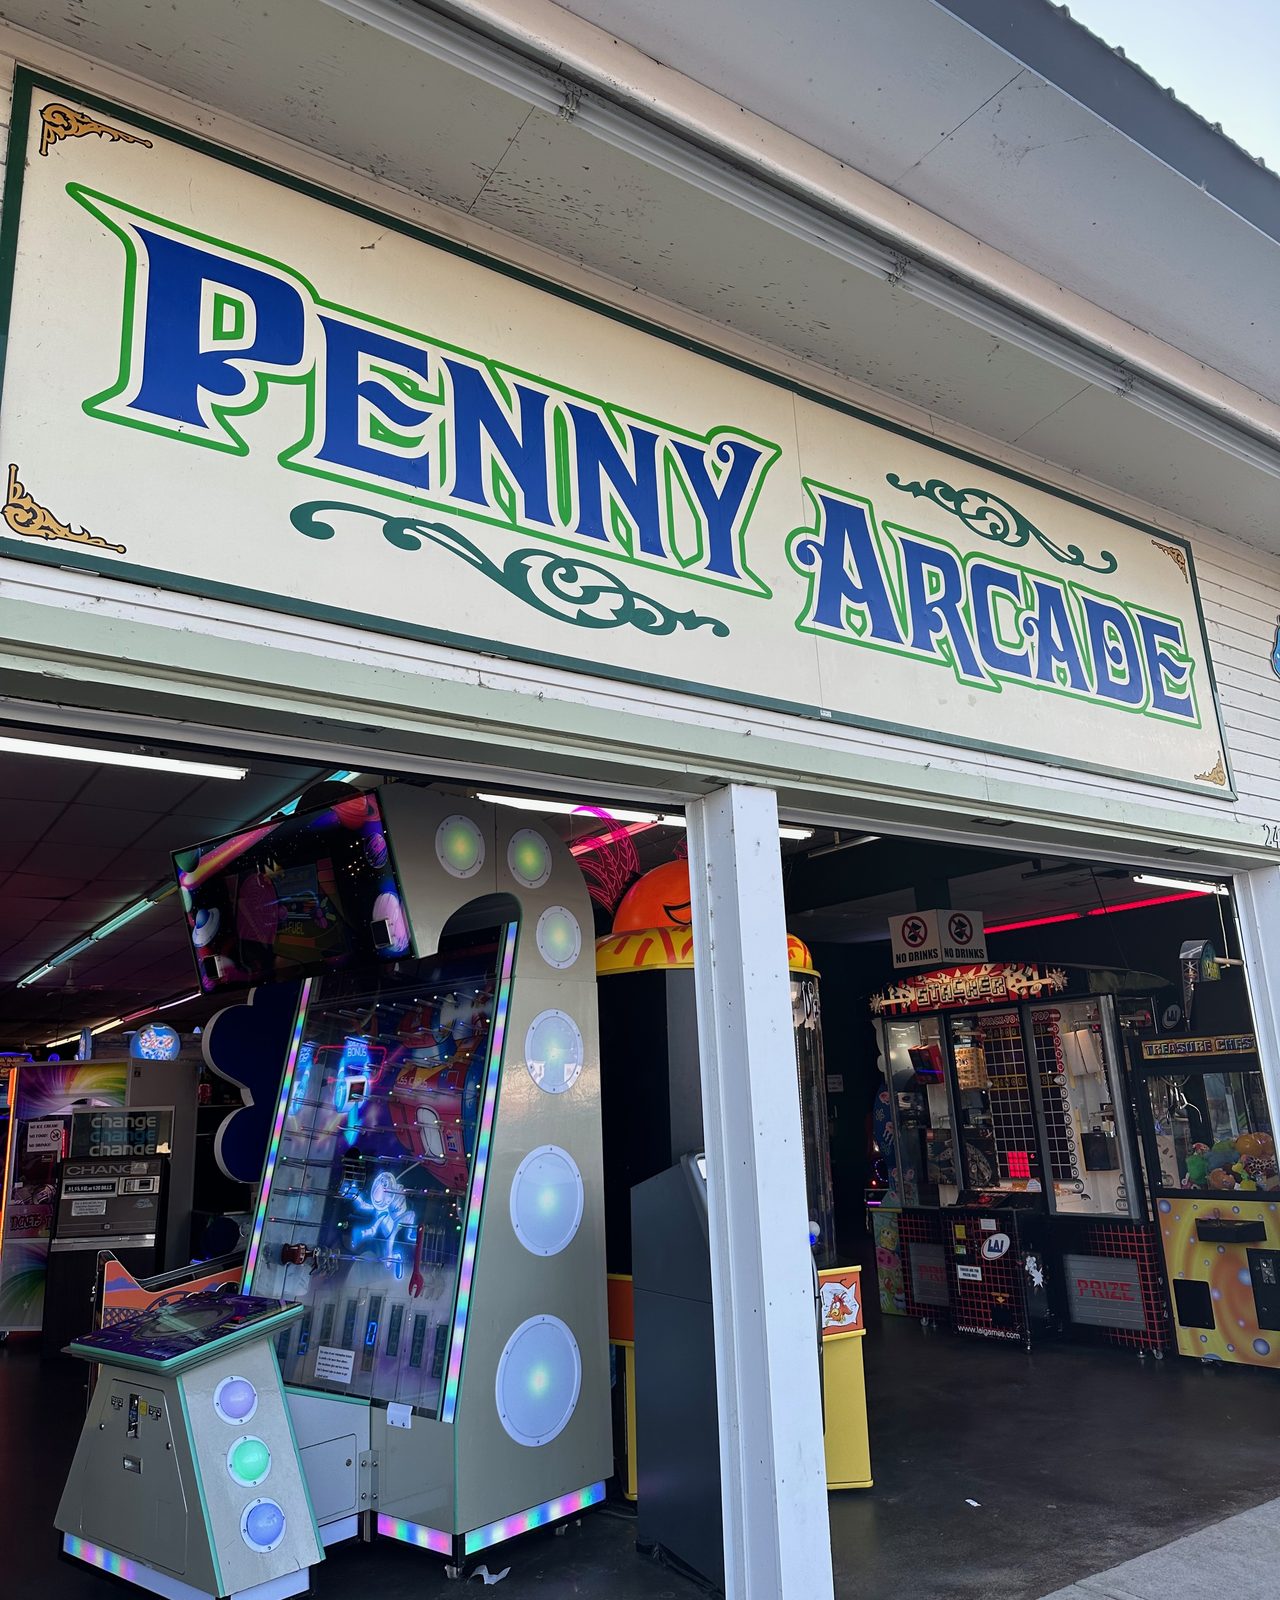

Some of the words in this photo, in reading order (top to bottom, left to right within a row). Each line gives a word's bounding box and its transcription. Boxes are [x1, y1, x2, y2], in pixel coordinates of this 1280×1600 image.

[66, 182, 781, 599] PENNY
[785, 477, 1201, 728] ARCADE
[896, 952, 907, 963] NO
[908, 949, 939, 962] DRINKS
[944, 947, 953, 957] NO
[954, 948, 985, 959] DRINKS
[917, 975, 1006, 1006] STACKER
[347, 1048, 367, 1057] BONUS
[1144, 1040, 1212, 1055] TREASURE
[91, 1114, 157, 1130] change
[90, 1129, 156, 1143] change
[89, 1143, 156, 1157] change
[66, 1165, 133, 1176] CHANG
[987, 1239, 1005, 1254] LAI
[1077, 1279, 1135, 1302] PRIZE
[957, 1324, 1021, 1340] www.laigames.com
